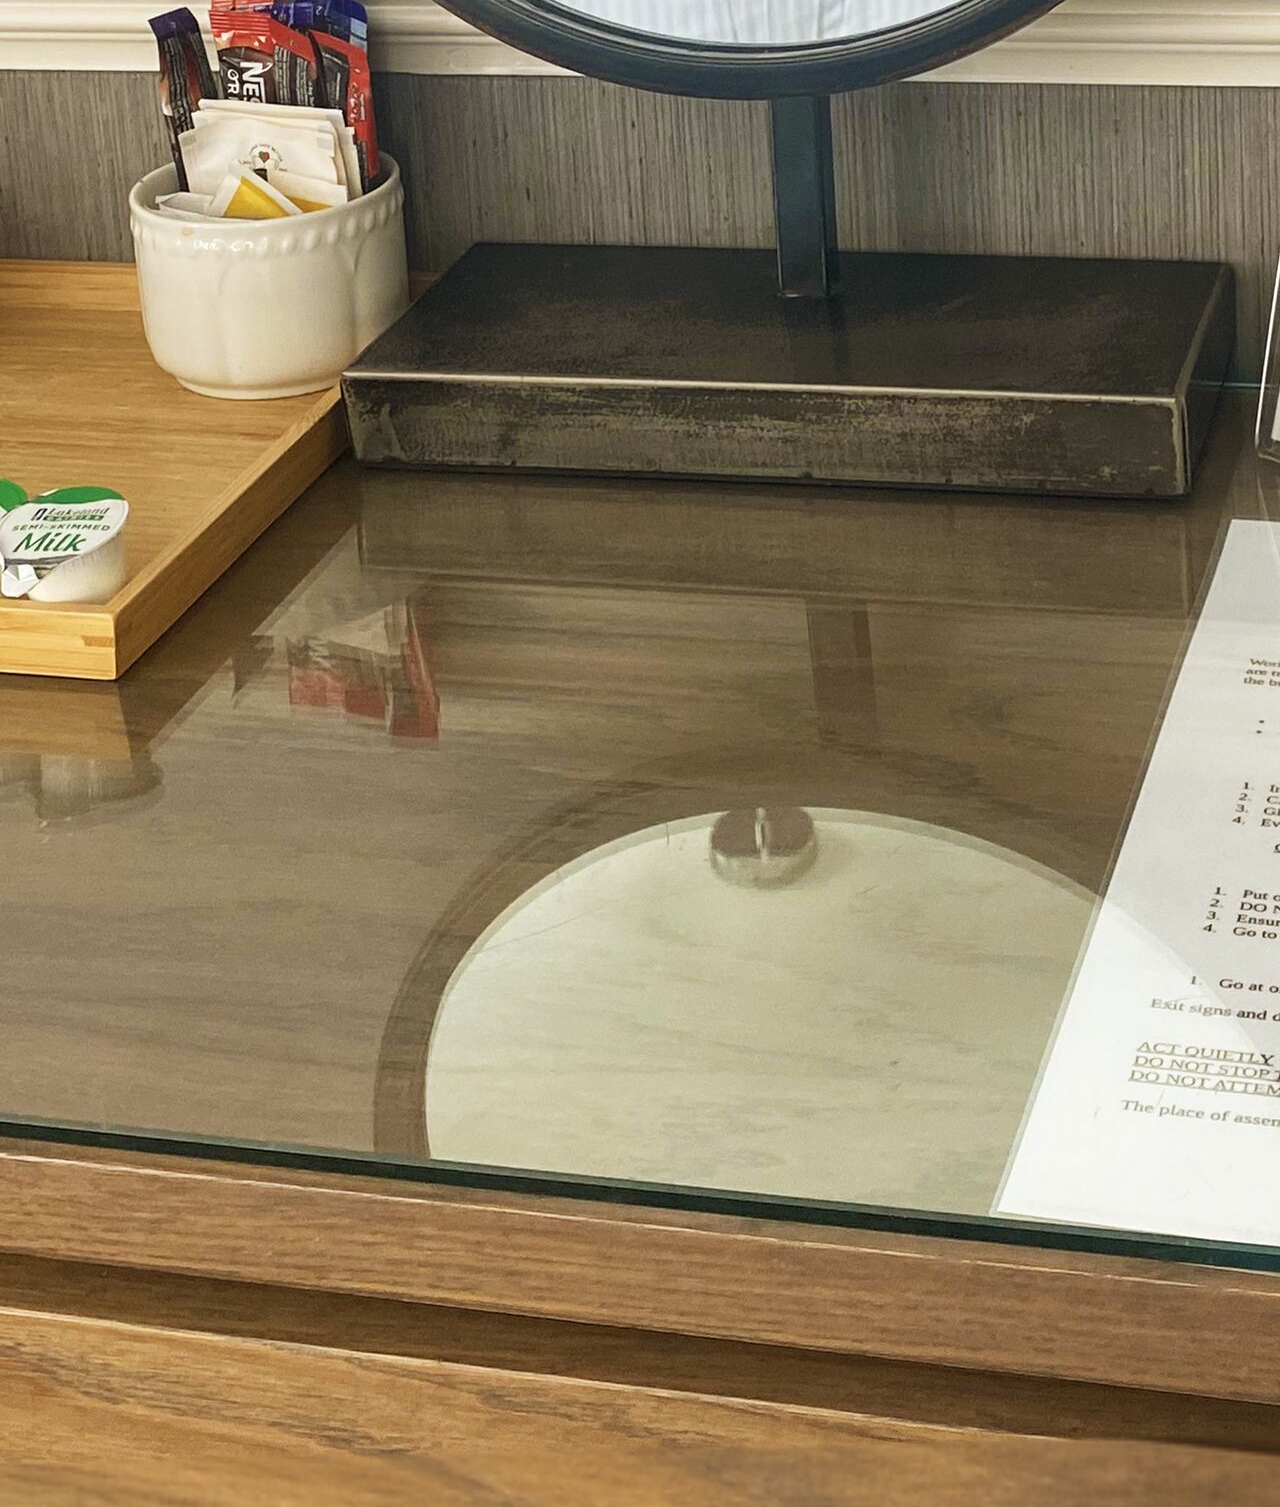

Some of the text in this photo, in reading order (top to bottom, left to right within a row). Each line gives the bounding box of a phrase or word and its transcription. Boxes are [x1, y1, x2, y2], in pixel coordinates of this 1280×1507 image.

[12, 523, 112, 532] SEMI-SKIMMED
[12, 532, 87, 553] Milk
[1135, 1040, 1276, 1065] ACT QUIETLY
[1132, 1054, 1165, 1068] DO
[1167, 1058, 1215, 1074] NOT
[1216, 1064, 1272, 1079] STOP
[1120, 1098, 1156, 1114] The
[1158, 1103, 1206, 1120] place
[1209, 1109, 1232, 1123] of
